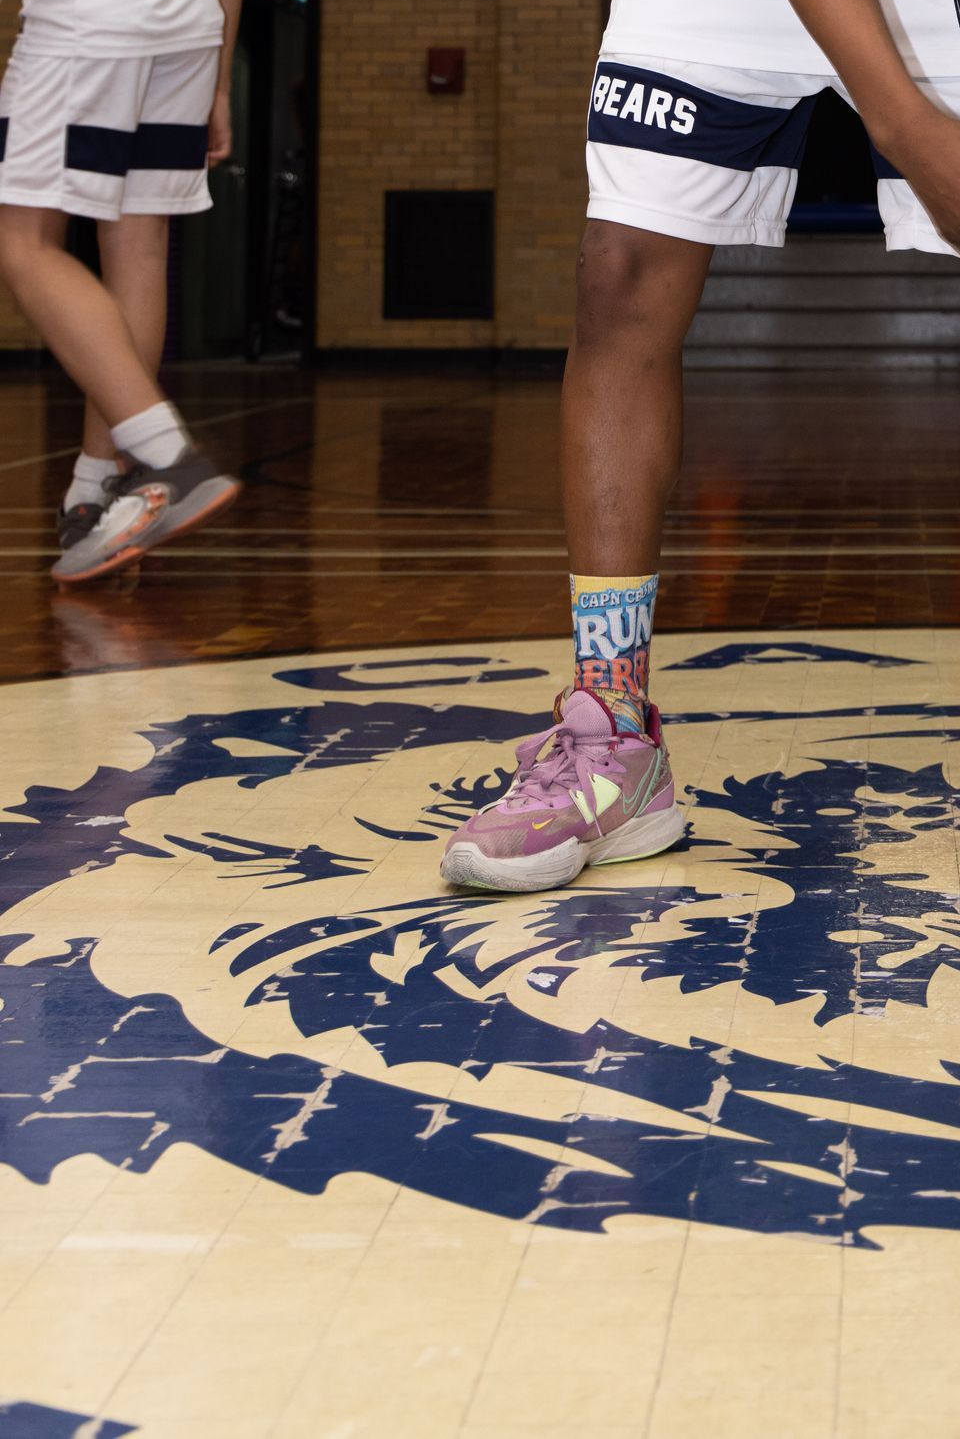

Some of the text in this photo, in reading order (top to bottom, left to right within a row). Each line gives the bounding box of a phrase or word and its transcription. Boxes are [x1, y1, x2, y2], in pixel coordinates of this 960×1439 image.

[593, 75, 698, 135] BEARS
[572, 599, 656, 660] RUN
[580, 591, 622, 609] CAP'N
